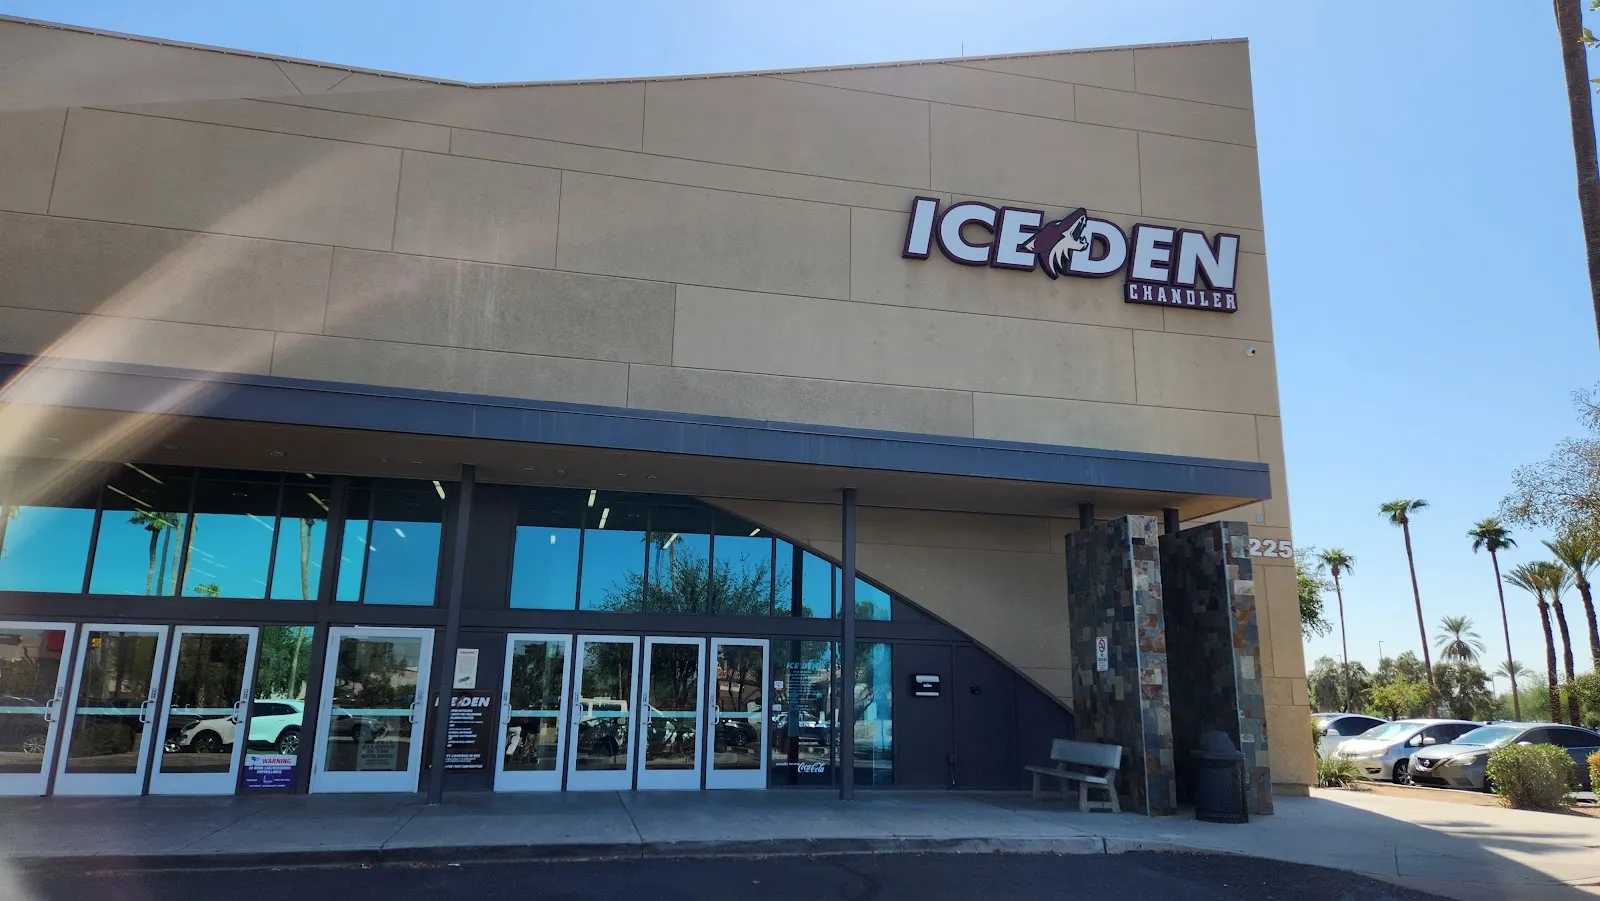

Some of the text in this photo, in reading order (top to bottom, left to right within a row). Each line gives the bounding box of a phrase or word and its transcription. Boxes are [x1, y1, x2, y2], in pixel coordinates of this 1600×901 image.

[902, 196, 1241, 292] ICE DEN
[1128, 283, 1238, 311] CHANDLER
[1248, 537, 1294, 559] 225
[434, 696, 459, 707] IE
[460, 696, 491, 707] DEN
